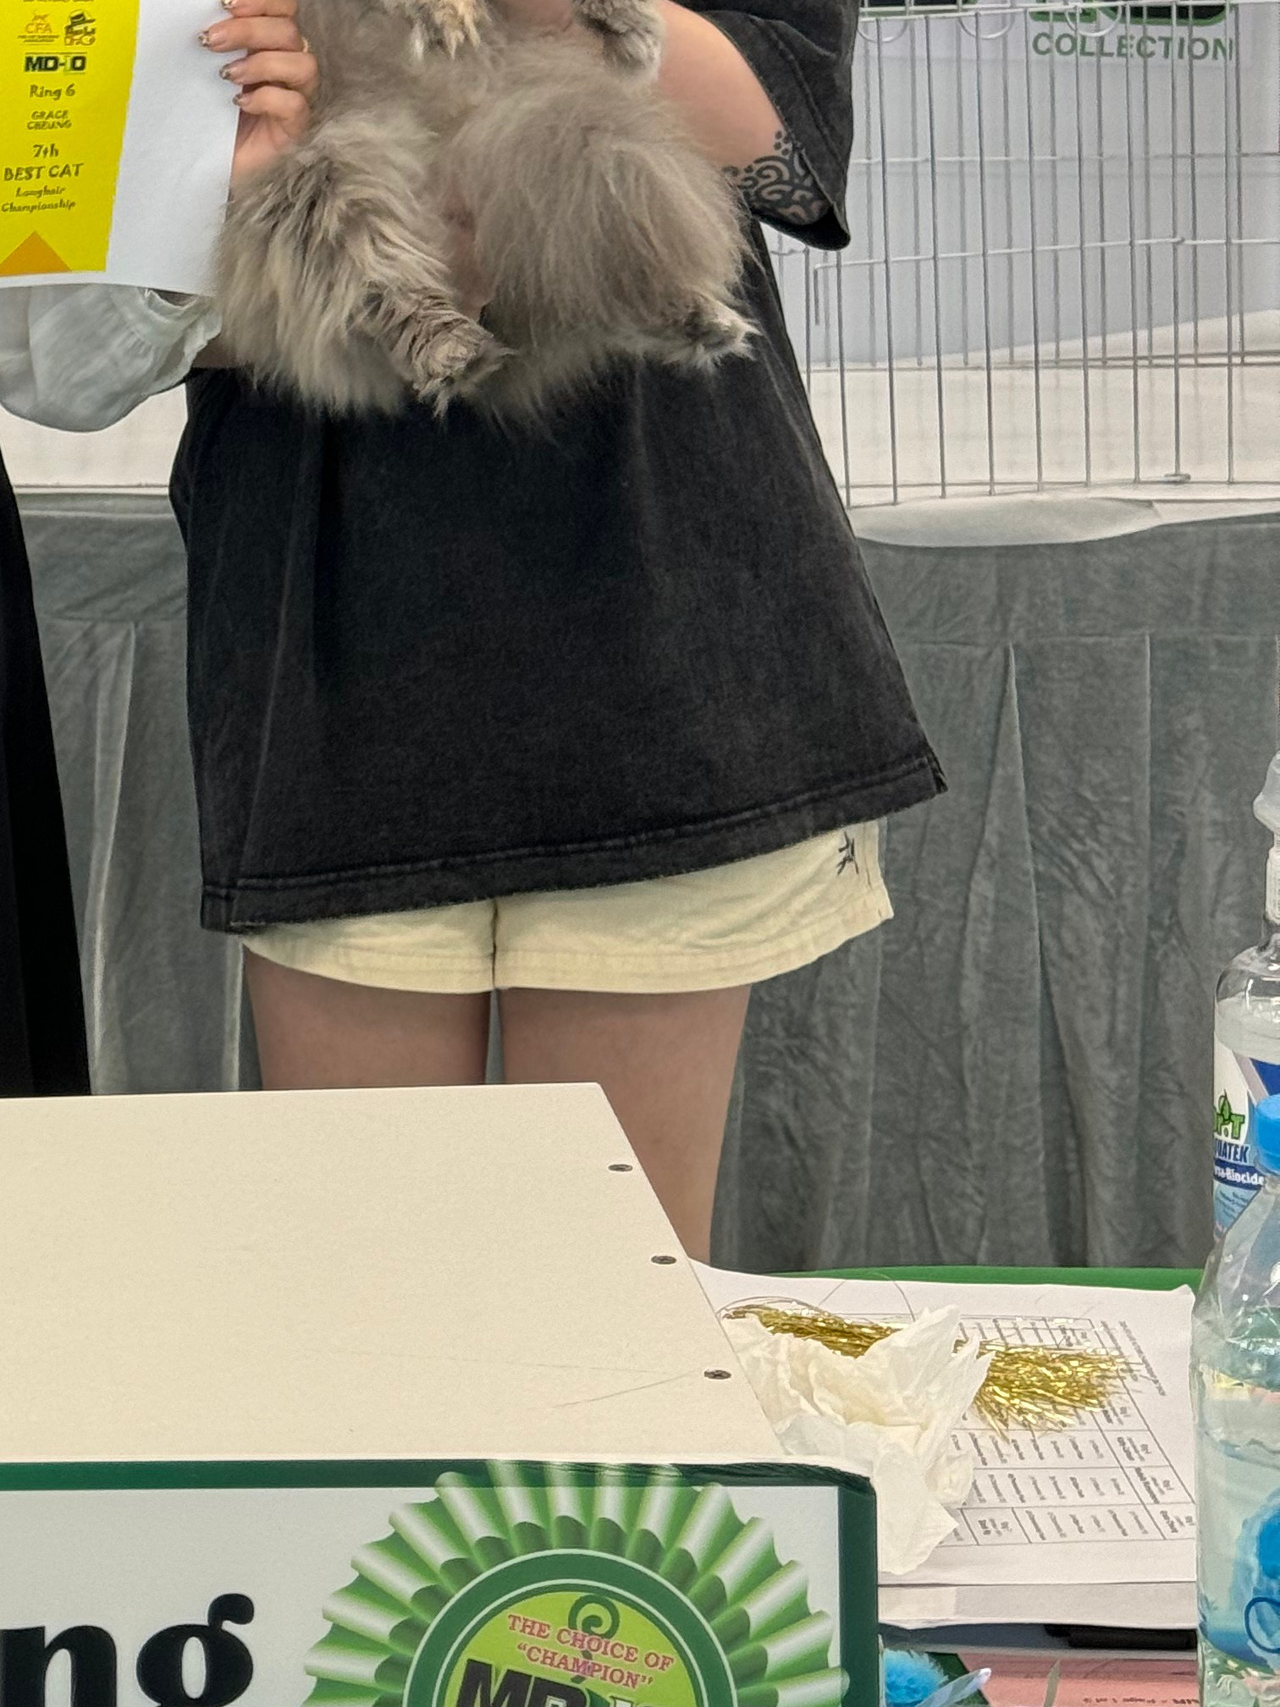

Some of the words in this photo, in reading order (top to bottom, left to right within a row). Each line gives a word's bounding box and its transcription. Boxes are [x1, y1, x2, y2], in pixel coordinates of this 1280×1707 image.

[1032, 32, 1234, 61] COLLECTION
[30, 84, 62, 101] Ring
[66, 84, 75, 97] 6
[33, 143, 59, 158] 7th
[4, 165, 45, 182] BEST
[48, 163, 84, 178] CAT
[507, 1614, 551, 1640] THE
[556, 1627, 638, 1663] CHOICE
[644, 1651, 674, 1672] OF
